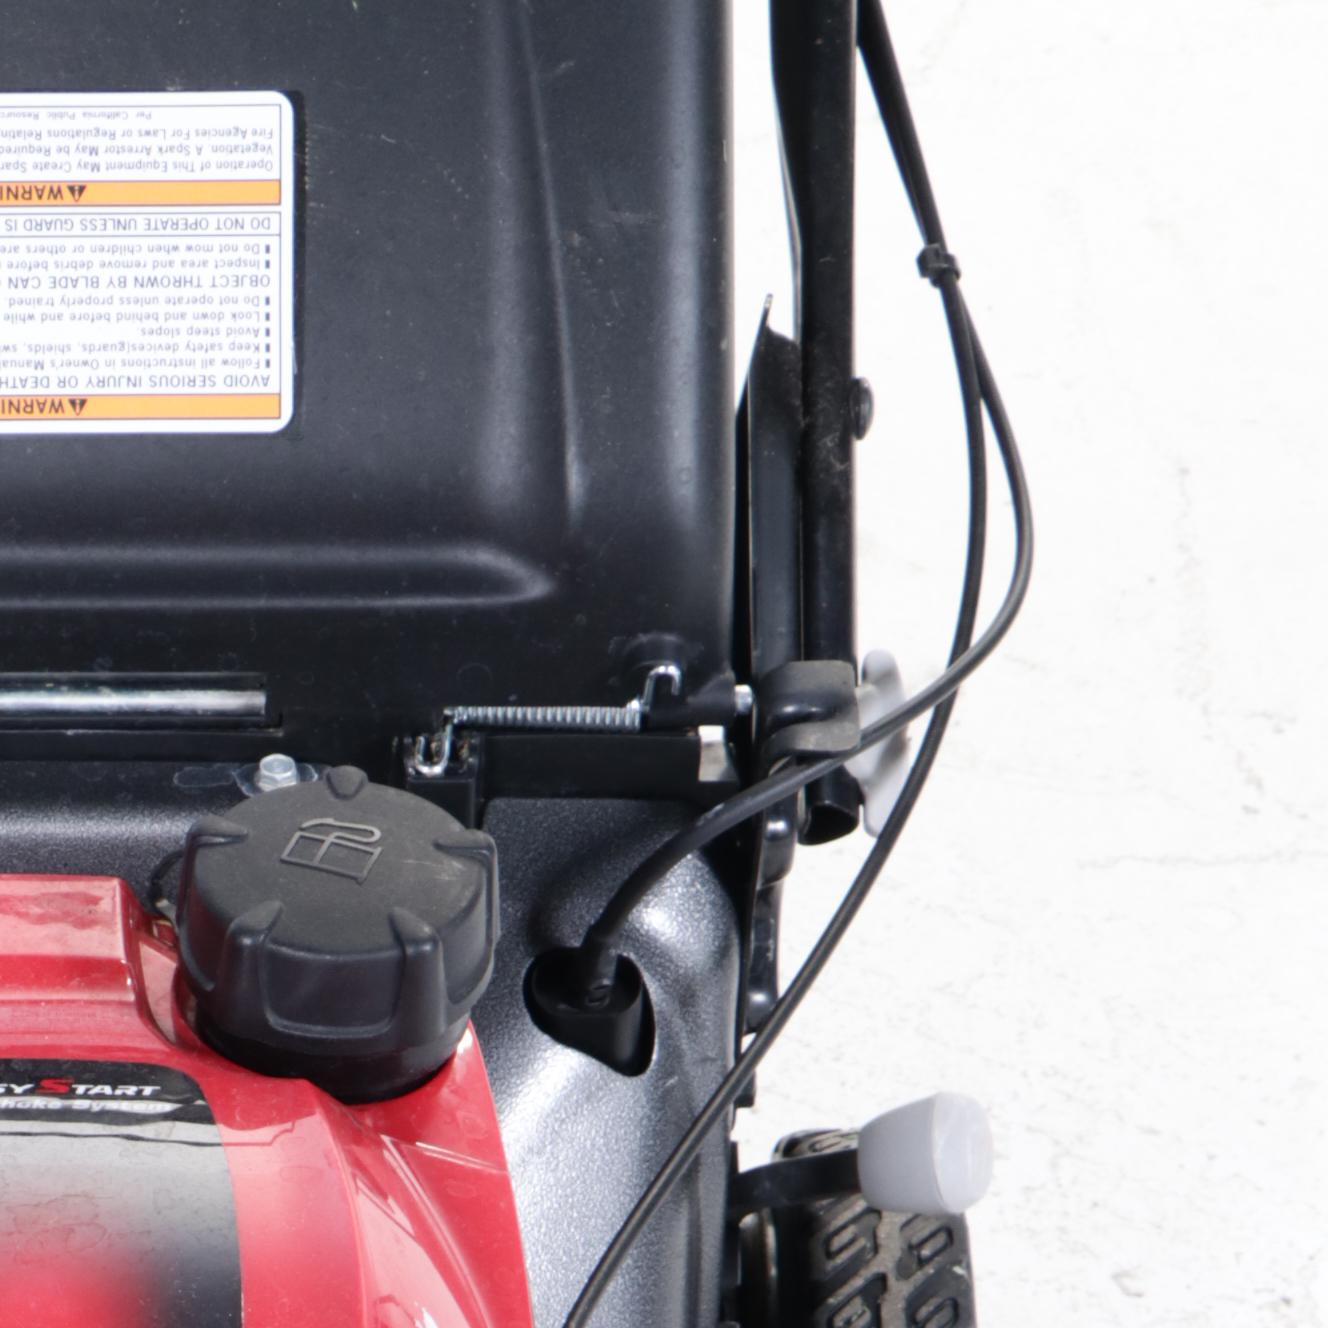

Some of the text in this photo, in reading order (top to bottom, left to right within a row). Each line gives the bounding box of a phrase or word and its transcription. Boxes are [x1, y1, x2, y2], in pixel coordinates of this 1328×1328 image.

[46, 111, 76, 121] Public
[81, 111, 129, 120] California
[135, 111, 152, 120] Per
[46, 126, 117, 141] Regulations
[120, 129, 133, 138] or
[137, 128, 167, 141] Laws
[170, 128, 191, 141] For
[194, 126, 248, 140] Agencies
[251, 128, 274, 140] Fire
[55, 145, 71, 157] be
[74, 143, 100, 157] May
[103, 145, 153, 157] Arrestor
[156, 143, 191, 157] Spark
[195, 145, 204, 156] A
[32, 161, 72, 174] Create
[76, 159, 101, 174] May
[105, 159, 168, 173] Equipment
[172, 161, 196, 173] This
[199, 160, 212, 172] of
[215, 158, 274, 172] Operation
[4, 218, 18, 232] IS
[22, 218, 74, 232] GUARD
[79, 217, 138, 232] UNLESS
[143, 217, 210, 232] OPERATE
[214, 217, 245, 231] NOT
[250, 216, 271, 231] DO
[0, 245, 20, 254] are
[25, 244, 67, 257] others
[71, 244, 85, 254] or
[89, 244, 143, 256] children
[145, 244, 181, 256] when
[184, 243, 214, 253] mow
[218, 243, 239, 254] not
[243, 243, 261, 255] Do
[6, 260, 49, 272] before
[53, 260, 94, 272] debris
[99, 259, 148, 269] remove
[152, 259, 176, 271] and
[180, 259, 210, 268] area
[214, 256, 261, 271] Inspect
[7, 276, 42, 290] CAN
[48, 275, 100, 289] BLADE
[106, 275, 128, 289] BY
[133, 275, 204, 289] THROWN
[209, 274, 271, 288] OBJECT
[4, 293, 262, 309] Do not operate unless properly trained.
[3, 312, 36, 325] while
[40, 312, 64, 324] and
[69, 312, 112, 324] before
[115, 311, 160, 324] behind
[163, 311, 188, 323] and
[192, 311, 225, 323] down
[230, 311, 260, 323] Look
[137, 325, 262, 339] Avoid steep slopes.
[23, 342, 72, 355] shields,
[184, 340, 224, 354] safety
[228, 340, 261, 354] Keep
[49, 358, 100, 371] Owner's
[104, 359, 116, 369] in
[120, 358, 196, 370] instructions
[201, 358, 216, 369] all
[220, 358, 261, 370] Follow
[56, 375, 79, 389] OR
[85, 375, 142, 389] INJURY
[148, 374, 217, 388] SERIOUS
[223, 374, 271, 388] AVOID
[71, 1098, 172, 1113] System
